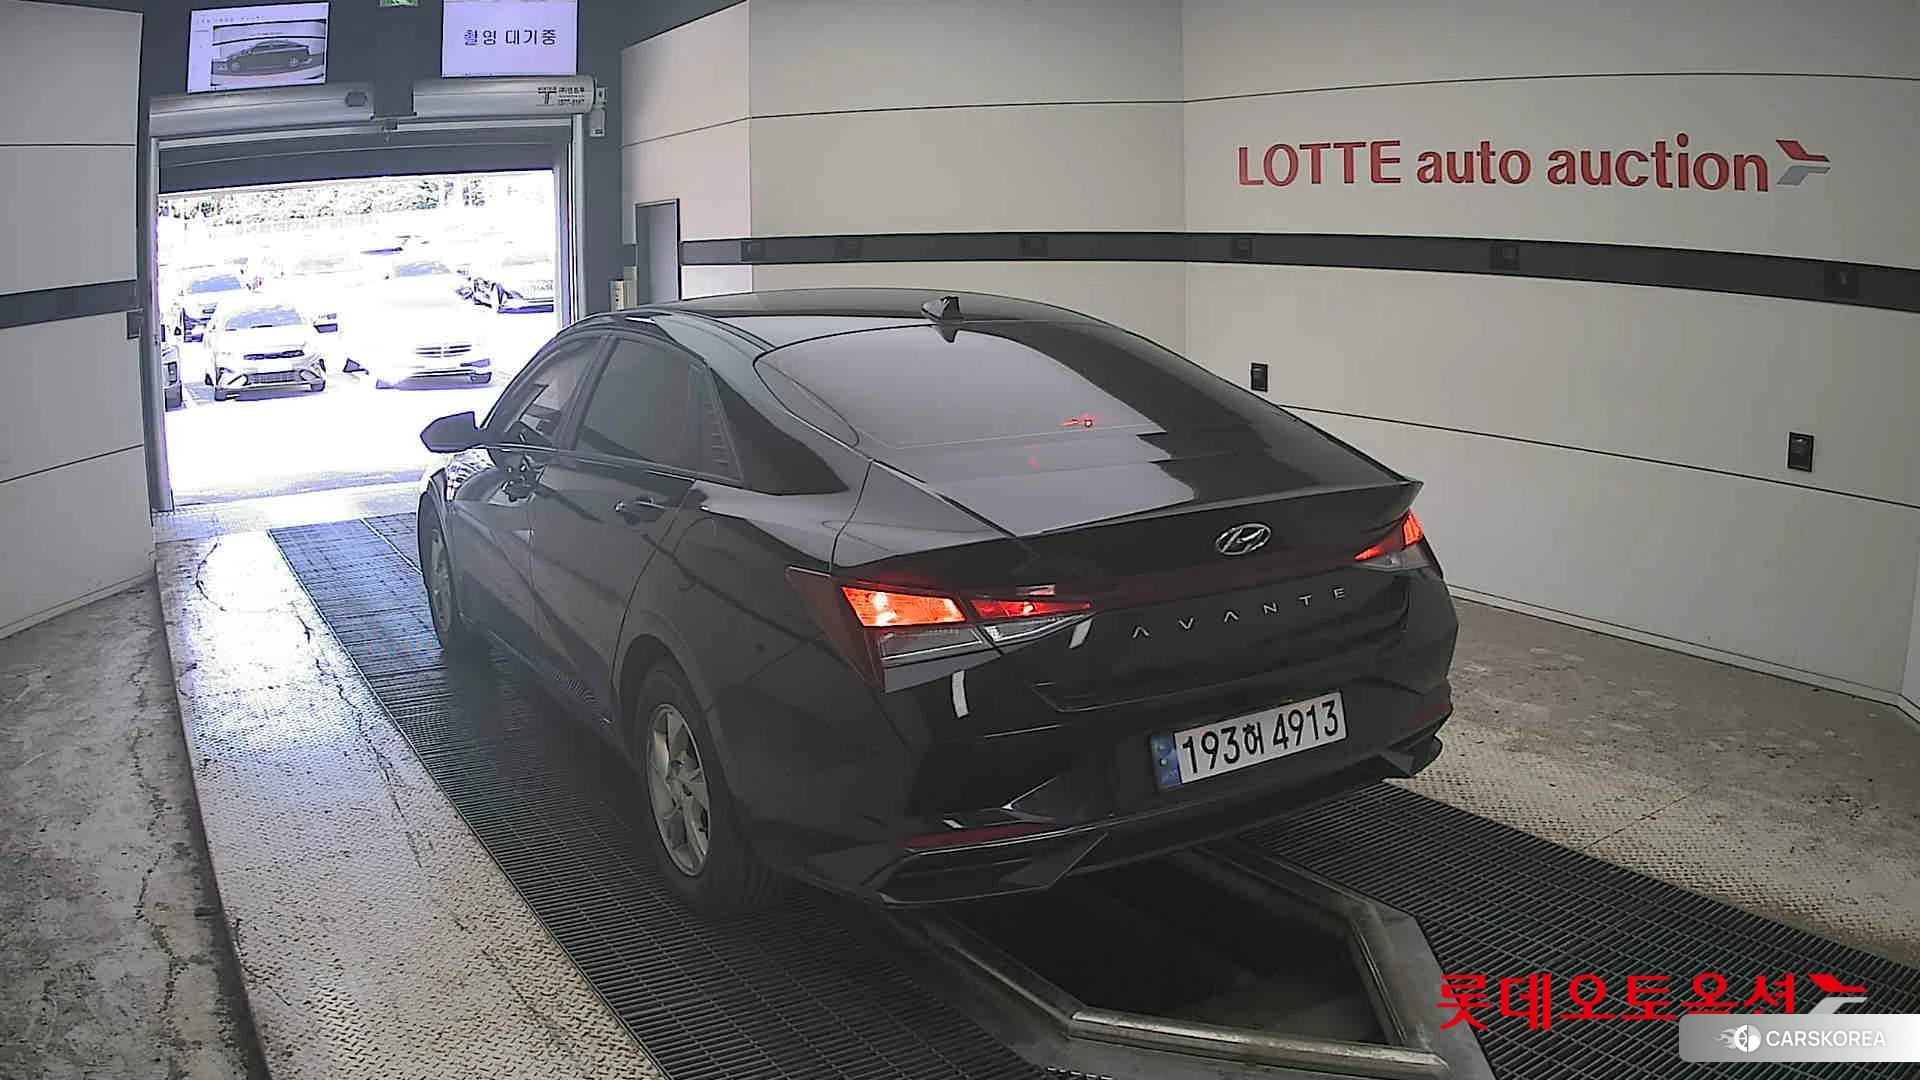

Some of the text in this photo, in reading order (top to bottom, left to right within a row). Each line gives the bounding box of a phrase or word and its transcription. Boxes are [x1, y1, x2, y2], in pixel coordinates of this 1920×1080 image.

[505, 29, 556, 46] 대기중
[1238, 132, 1769, 192] LOTTE auto auction
[1131, 587, 1346, 640] AVANTE
[1182, 700, 1339, 774] 193허 4913
